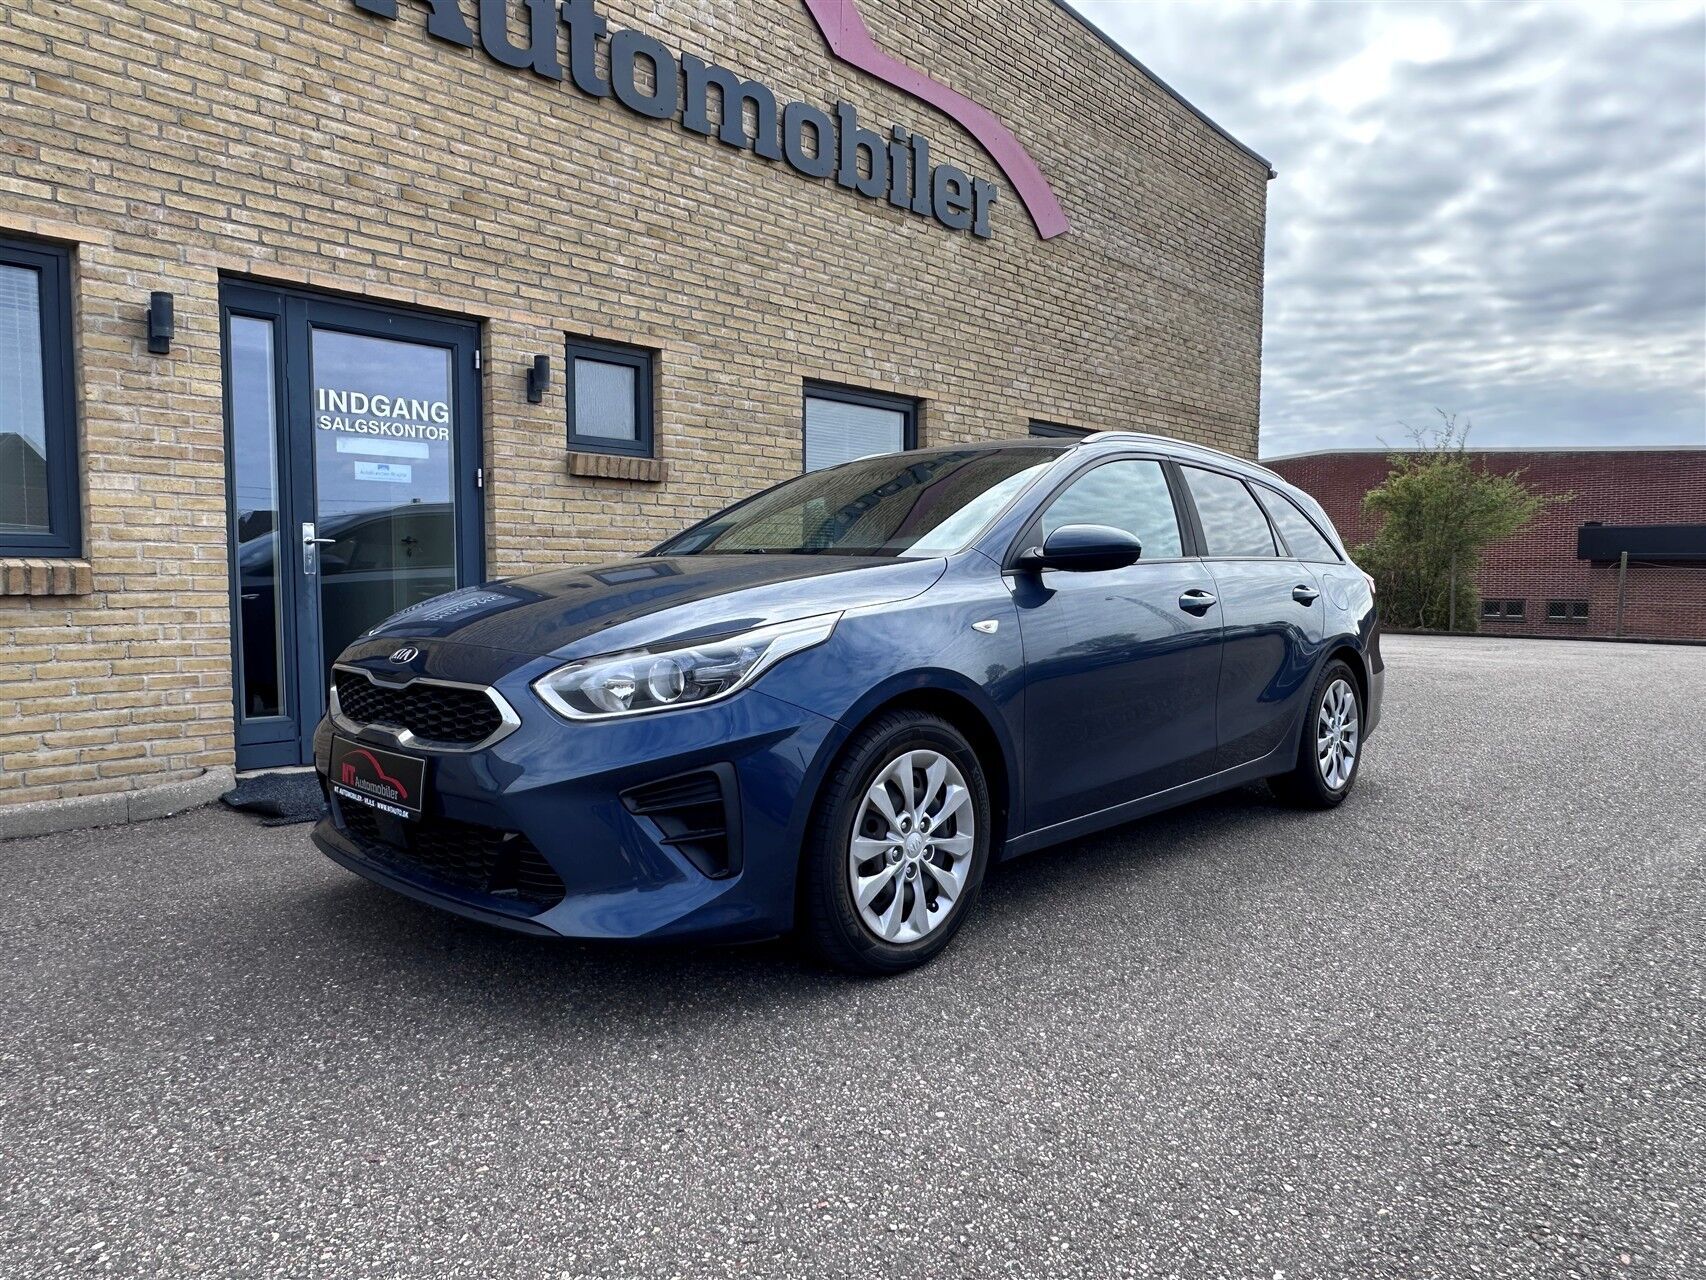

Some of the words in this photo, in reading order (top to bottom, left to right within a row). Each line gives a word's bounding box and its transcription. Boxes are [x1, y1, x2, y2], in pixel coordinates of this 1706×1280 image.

[319, 388, 449, 424] INDGANG
[320, 415, 449, 441] SALGSKONTOR
[390, 648, 413, 661] KIA
[355, 776, 398, 800] Automobiler
